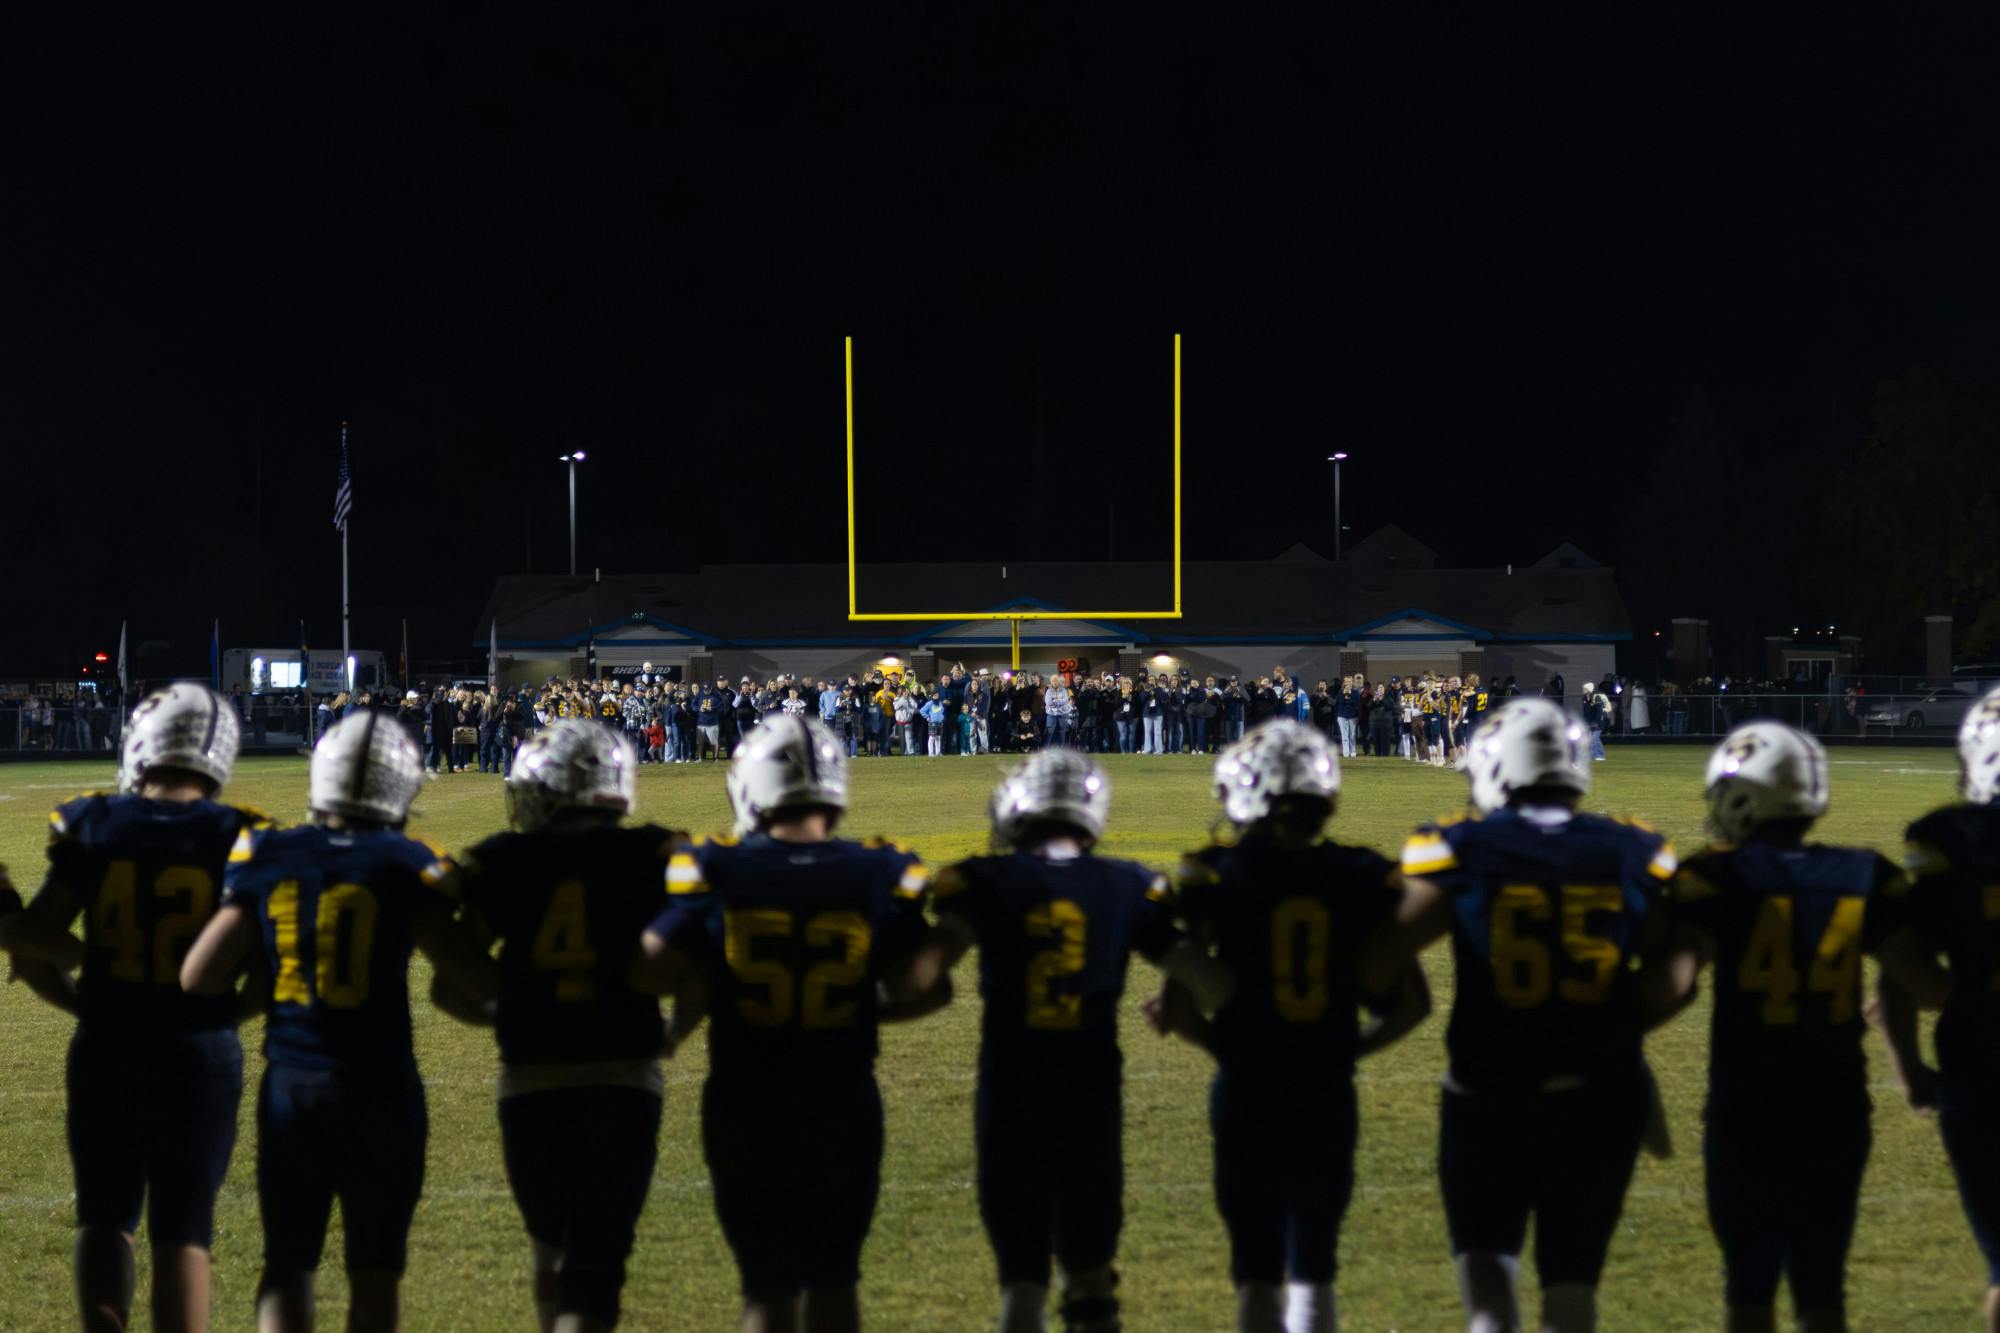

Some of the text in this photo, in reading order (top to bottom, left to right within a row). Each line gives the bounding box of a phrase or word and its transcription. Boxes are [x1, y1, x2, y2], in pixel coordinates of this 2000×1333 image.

[612, 666, 671, 674] SHEPERD
[93, 858, 217, 985] 42
[267, 879, 378, 1009] 10
[531, 880, 598, 1004] 4
[724, 907, 872, 1030] 52
[1024, 899, 1088, 1031] 2
[1271, 897, 1331, 1025] 0
[1489, 884, 1626, 1007] 65
[1737, 895, 1867, 1027] 44
